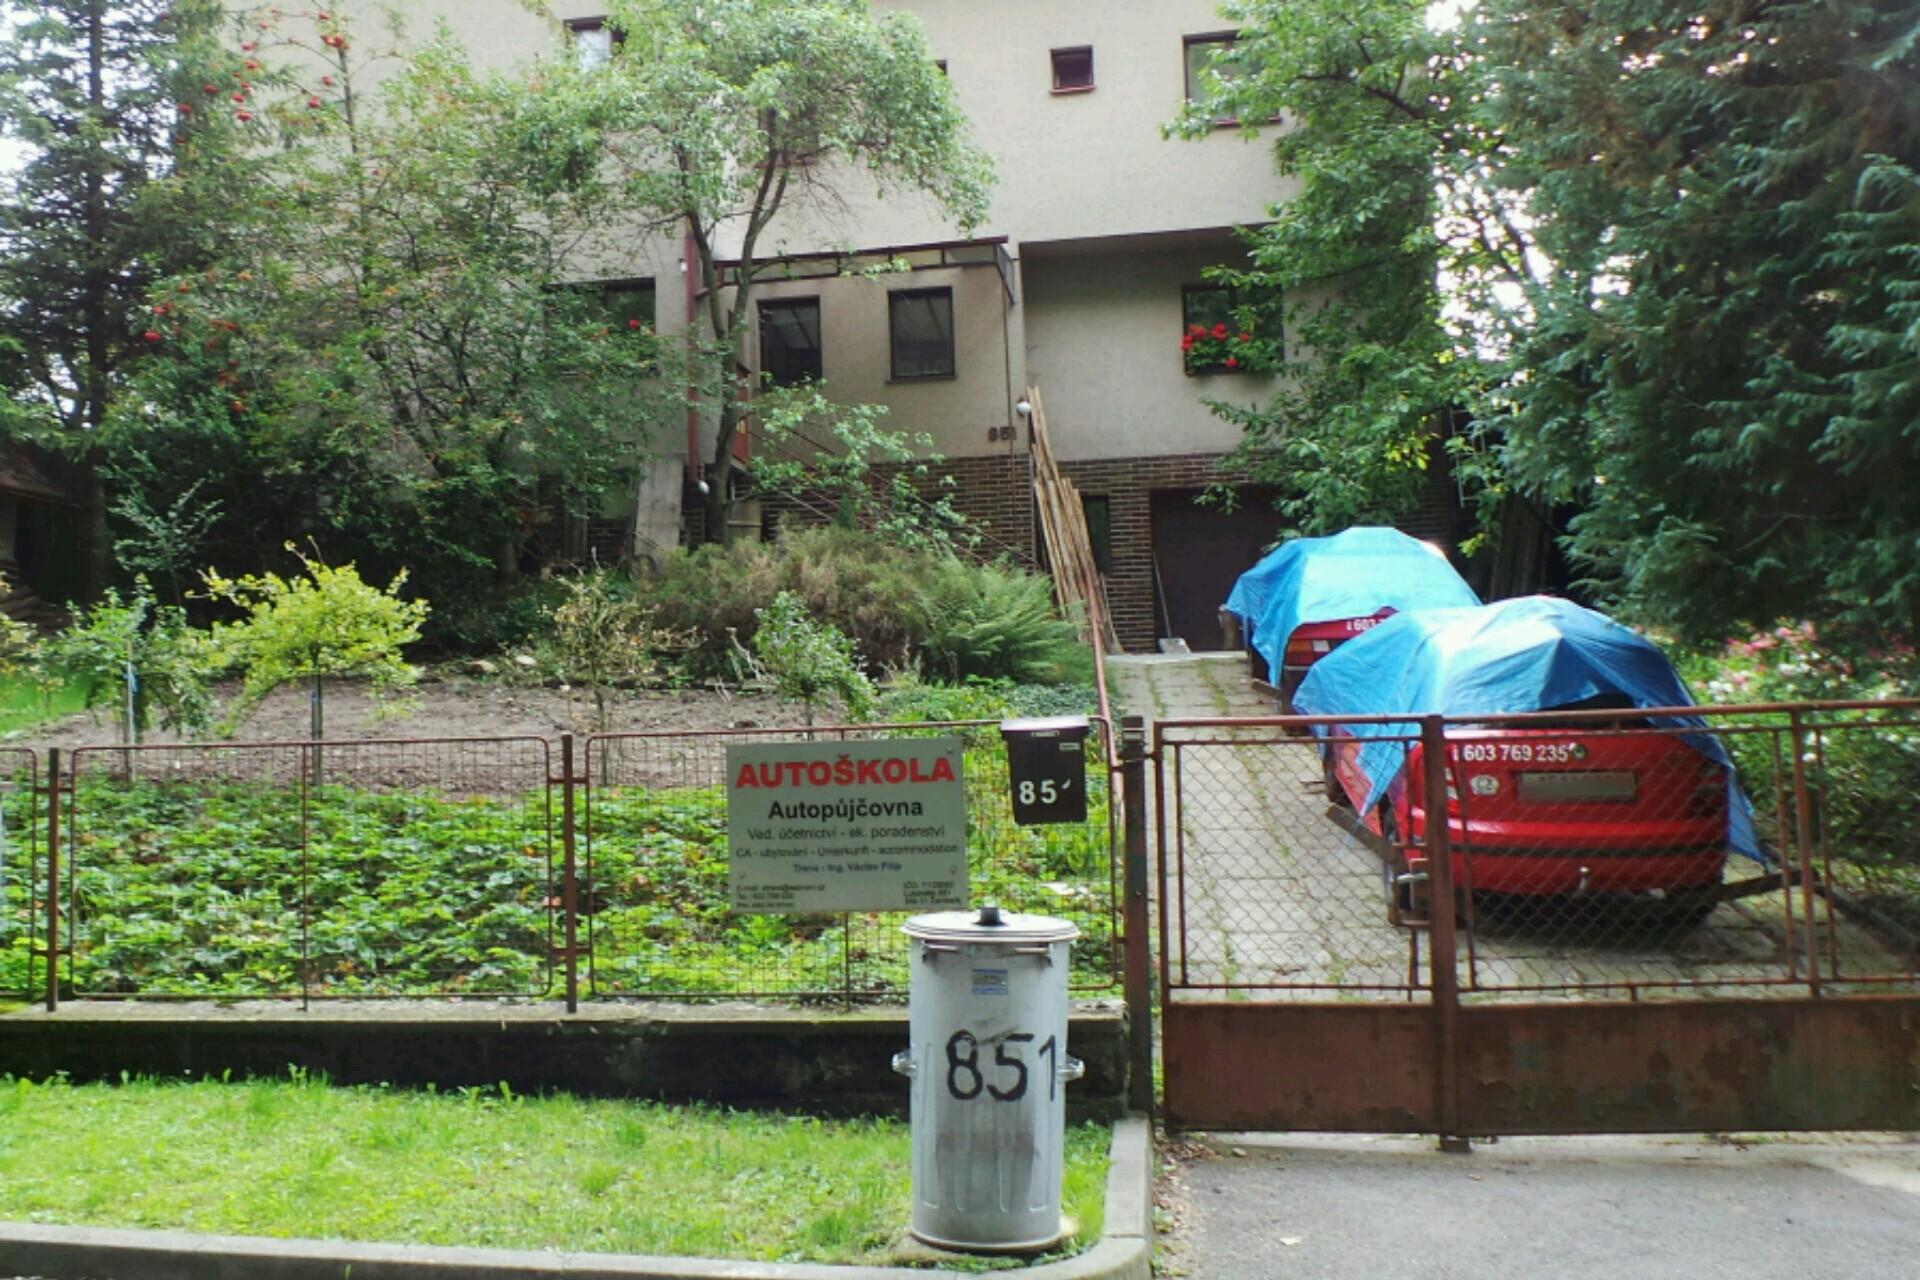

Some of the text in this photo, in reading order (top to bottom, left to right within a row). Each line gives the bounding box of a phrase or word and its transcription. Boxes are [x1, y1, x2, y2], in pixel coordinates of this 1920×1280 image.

[1463, 744, 1569, 761] 603 769 235
[735, 753, 956, 789] AUTOŠKOLA
[768, 798, 924, 822] Autopůjčovna
[871, 824, 945, 840] poradenství
[946, 1029, 1056, 1102] 851
